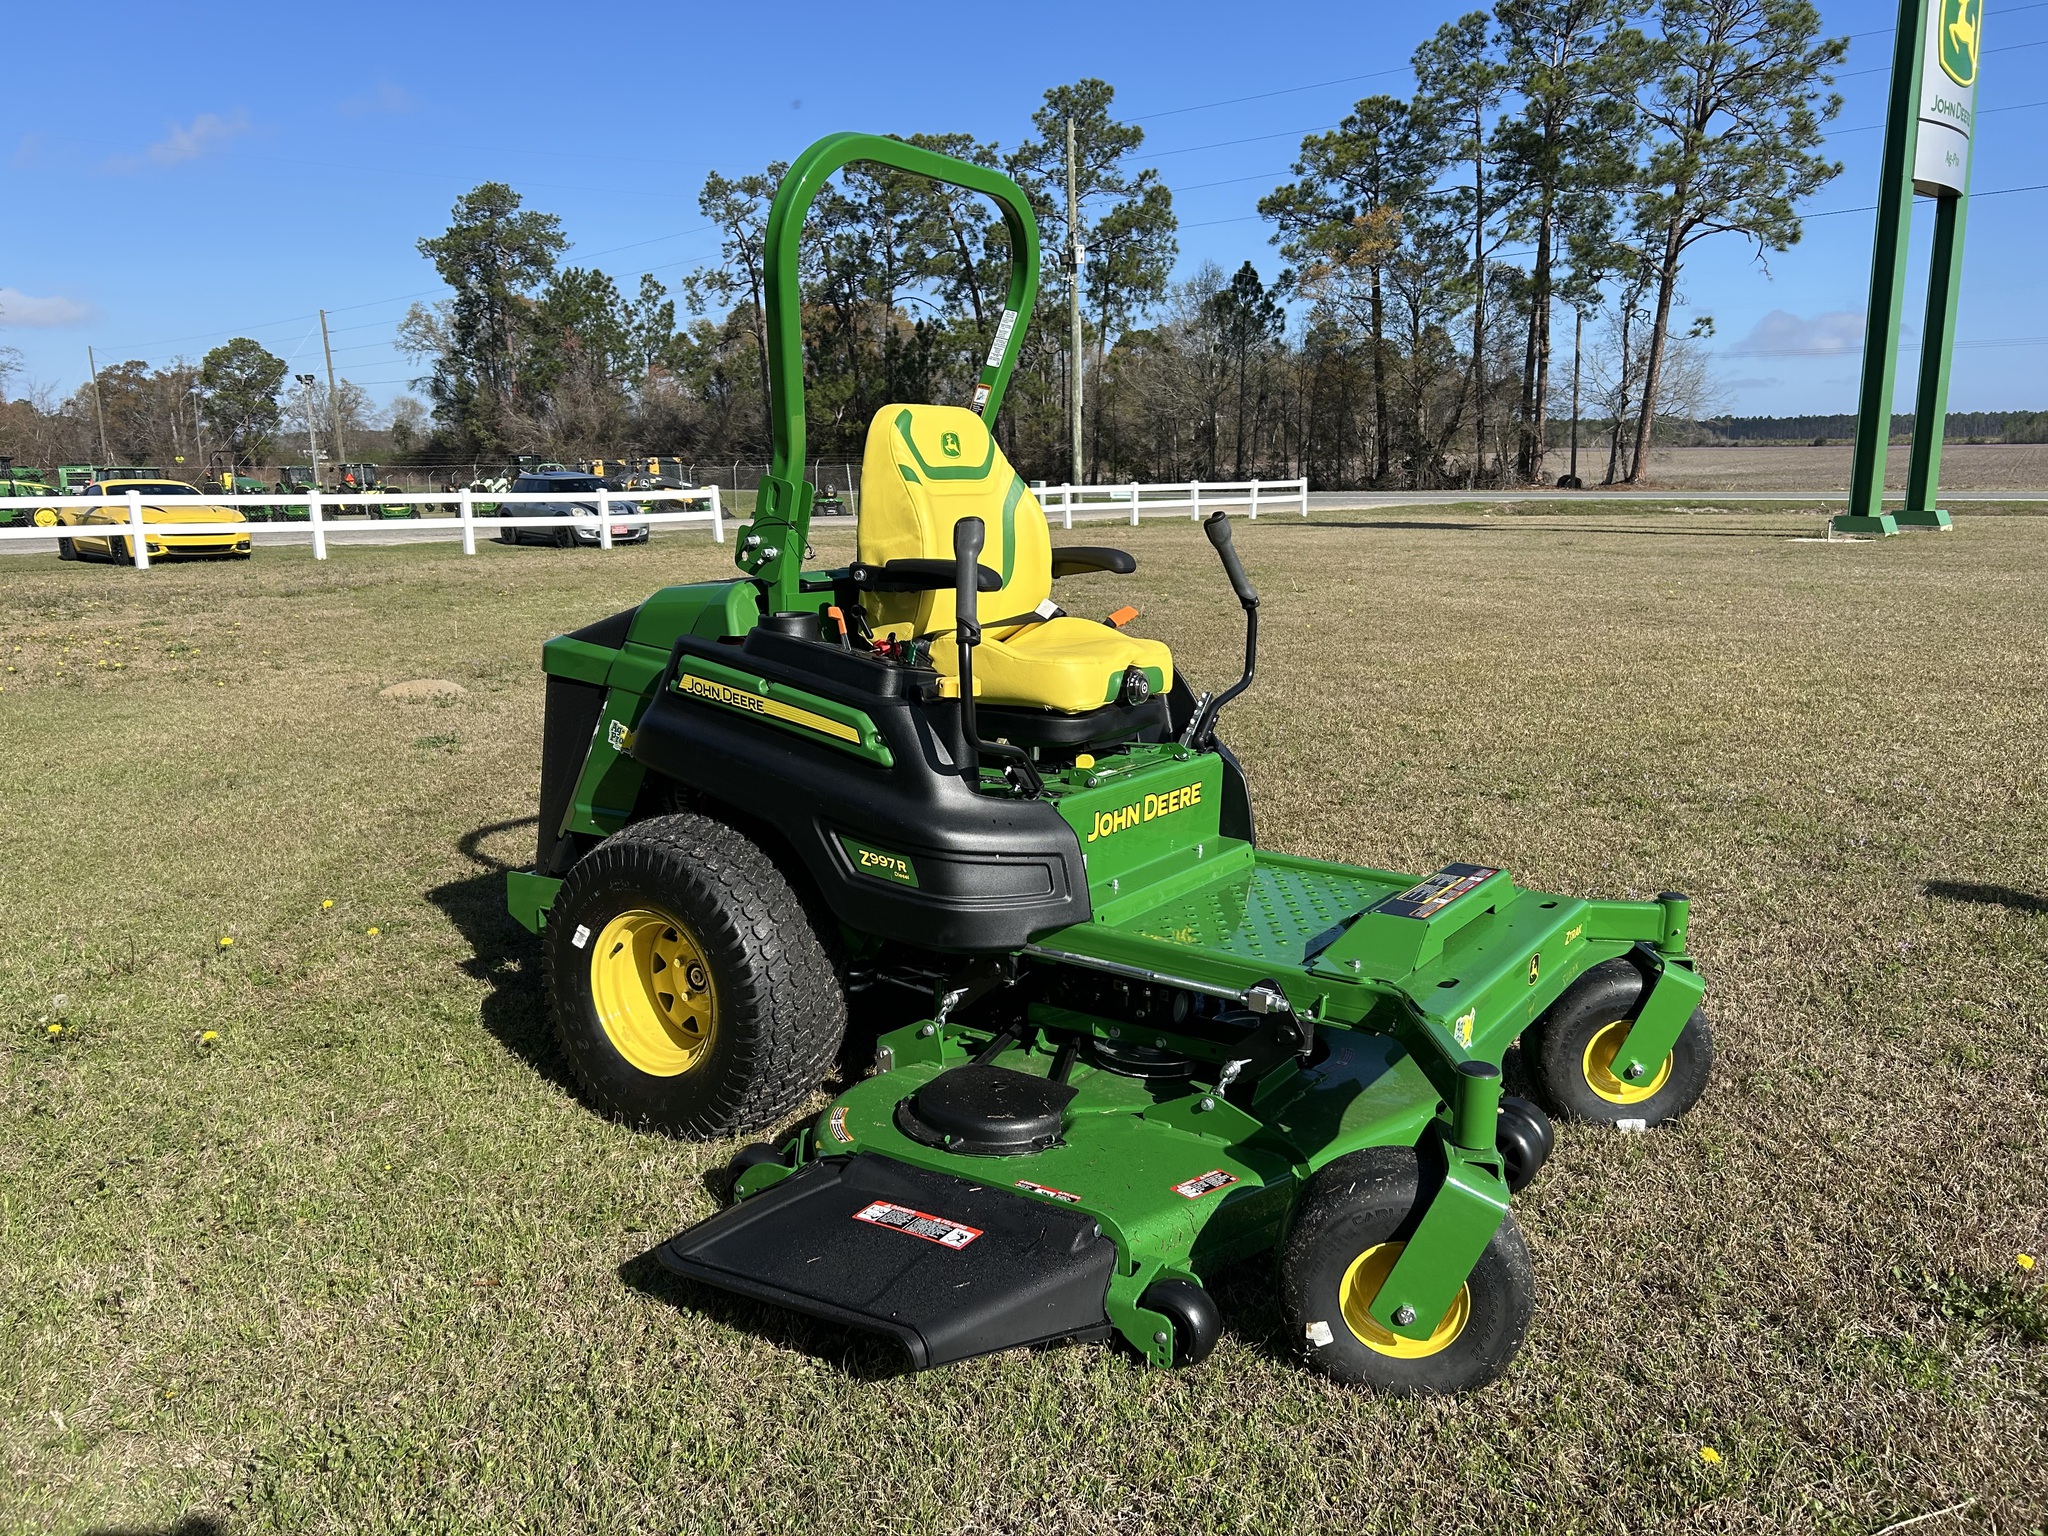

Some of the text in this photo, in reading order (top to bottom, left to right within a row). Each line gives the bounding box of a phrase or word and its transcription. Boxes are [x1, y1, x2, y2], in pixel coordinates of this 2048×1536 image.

[1931, 95, 1956, 118] JOHN
[687, 678, 764, 713] JOHN DEERE
[1087, 781, 1203, 843] JOHN DEERE
